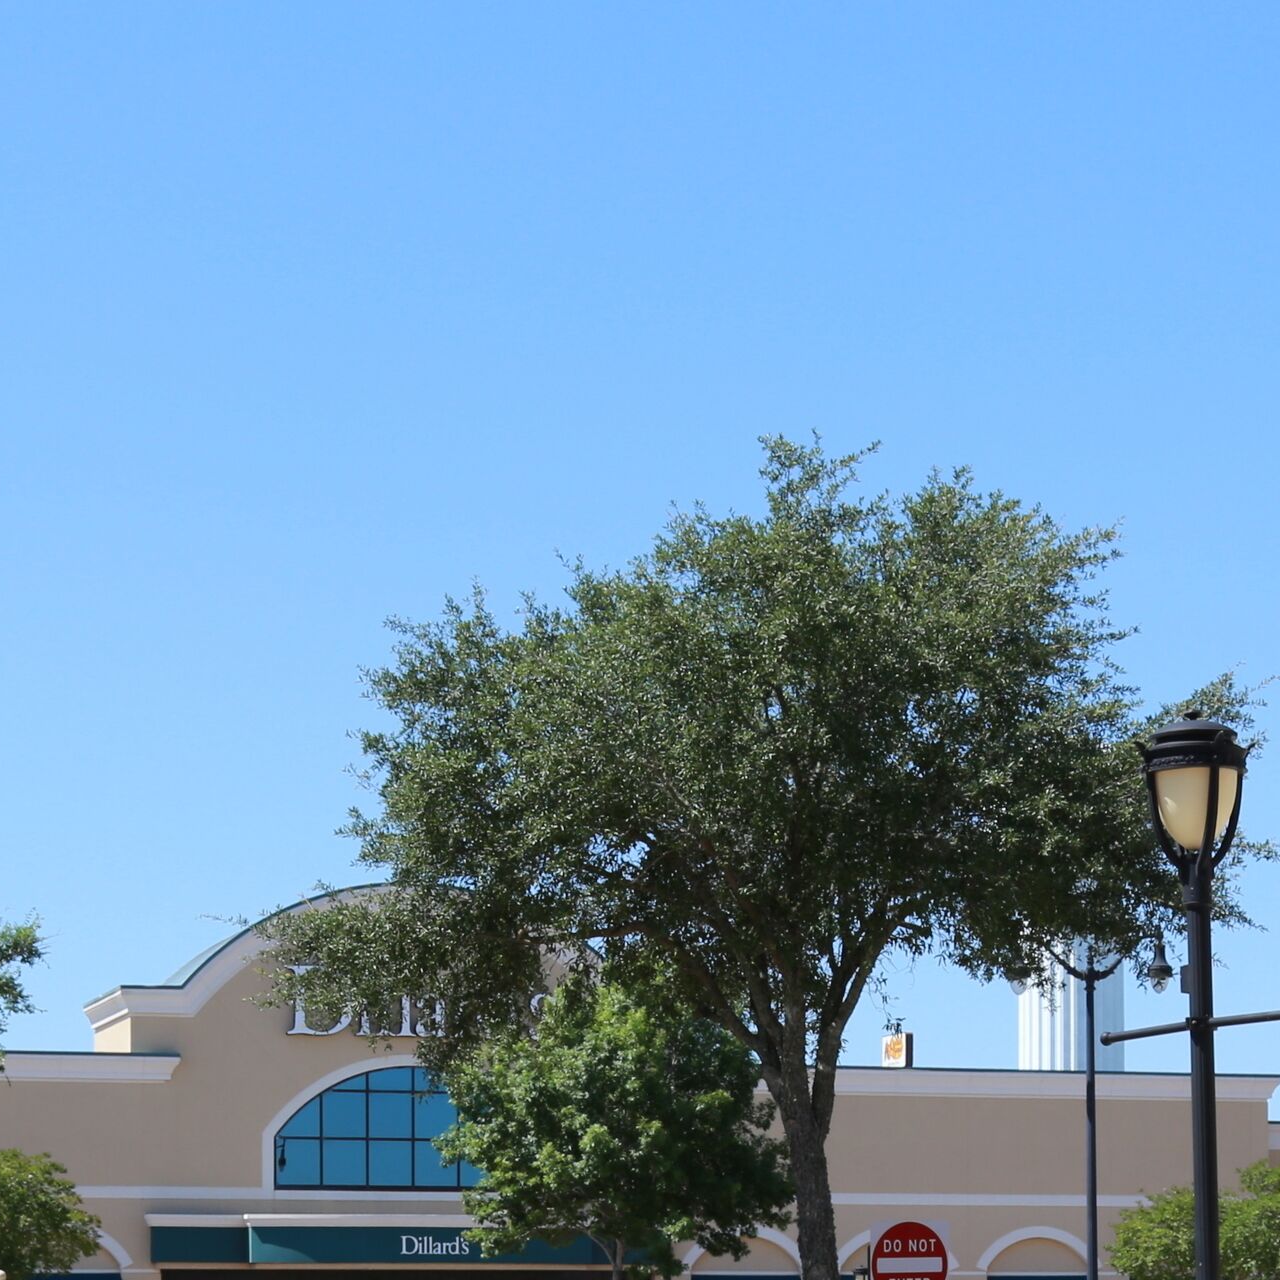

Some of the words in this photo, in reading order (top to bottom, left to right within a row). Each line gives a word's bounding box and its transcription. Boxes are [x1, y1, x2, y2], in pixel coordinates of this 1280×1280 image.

[400, 1235, 470, 1255] Dillard's
[883, 1239, 902, 1253] DO
[908, 1238, 937, 1253] NOT
